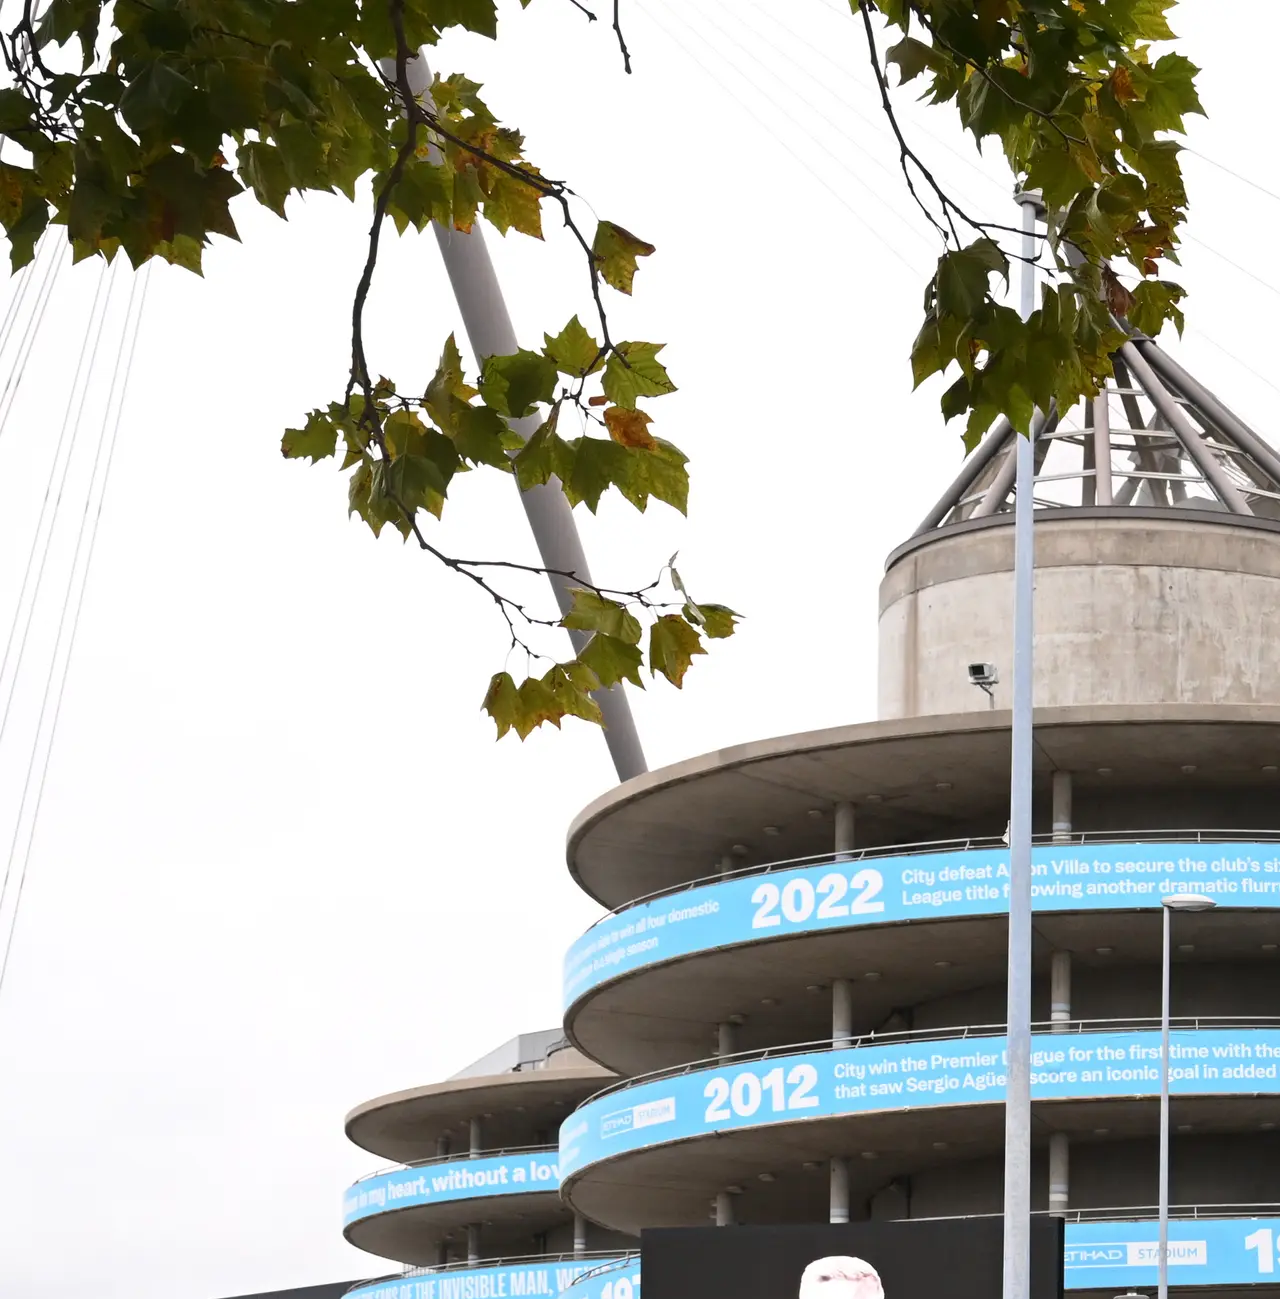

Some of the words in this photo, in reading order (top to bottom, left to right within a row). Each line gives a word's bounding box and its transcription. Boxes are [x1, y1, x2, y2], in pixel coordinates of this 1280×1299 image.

[902, 868, 935, 887] City
[938, 862, 993, 881] defeat
[1050, 859, 1090, 876] Villa
[1093, 858, 1112, 874] to
[1114, 859, 1175, 874] secure
[1178, 857, 1208, 873] the
[751, 868, 885, 930] 2022
[902, 887, 963, 906] League
[965, 882, 1000, 900] title
[1086, 878, 1156, 896] another
[1159, 877, 1238, 894] dramatic
[668, 900, 720, 924] domestic
[834, 1062, 866, 1080] City
[868, 1058, 898, 1076] win
[900, 1056, 928, 1073] the
[931, 1051, 998, 1070] Premier
[1068, 1046, 1093, 1062] for
[1097, 1044, 1126, 1061] the
[1168, 1043, 1209, 1059] time
[1212, 1042, 1252, 1059] with
[703, 1063, 820, 1123] 2012
[834, 1082, 867, 1100] that
[869, 1080, 903, 1096] saw
[906, 1073, 960, 1094] Sergio
[1029, 1066, 1078, 1085] score
[1081, 1068, 1102, 1082] an
[1106, 1064, 1159, 1081] iconic
[1203, 1064, 1219, 1080] in
[1222, 1064, 1277, 1080] added
[432, 1166, 509, 1193] without
[512, 1168, 526, 1183] a
[510, 1269, 554, 1297] MAN,
